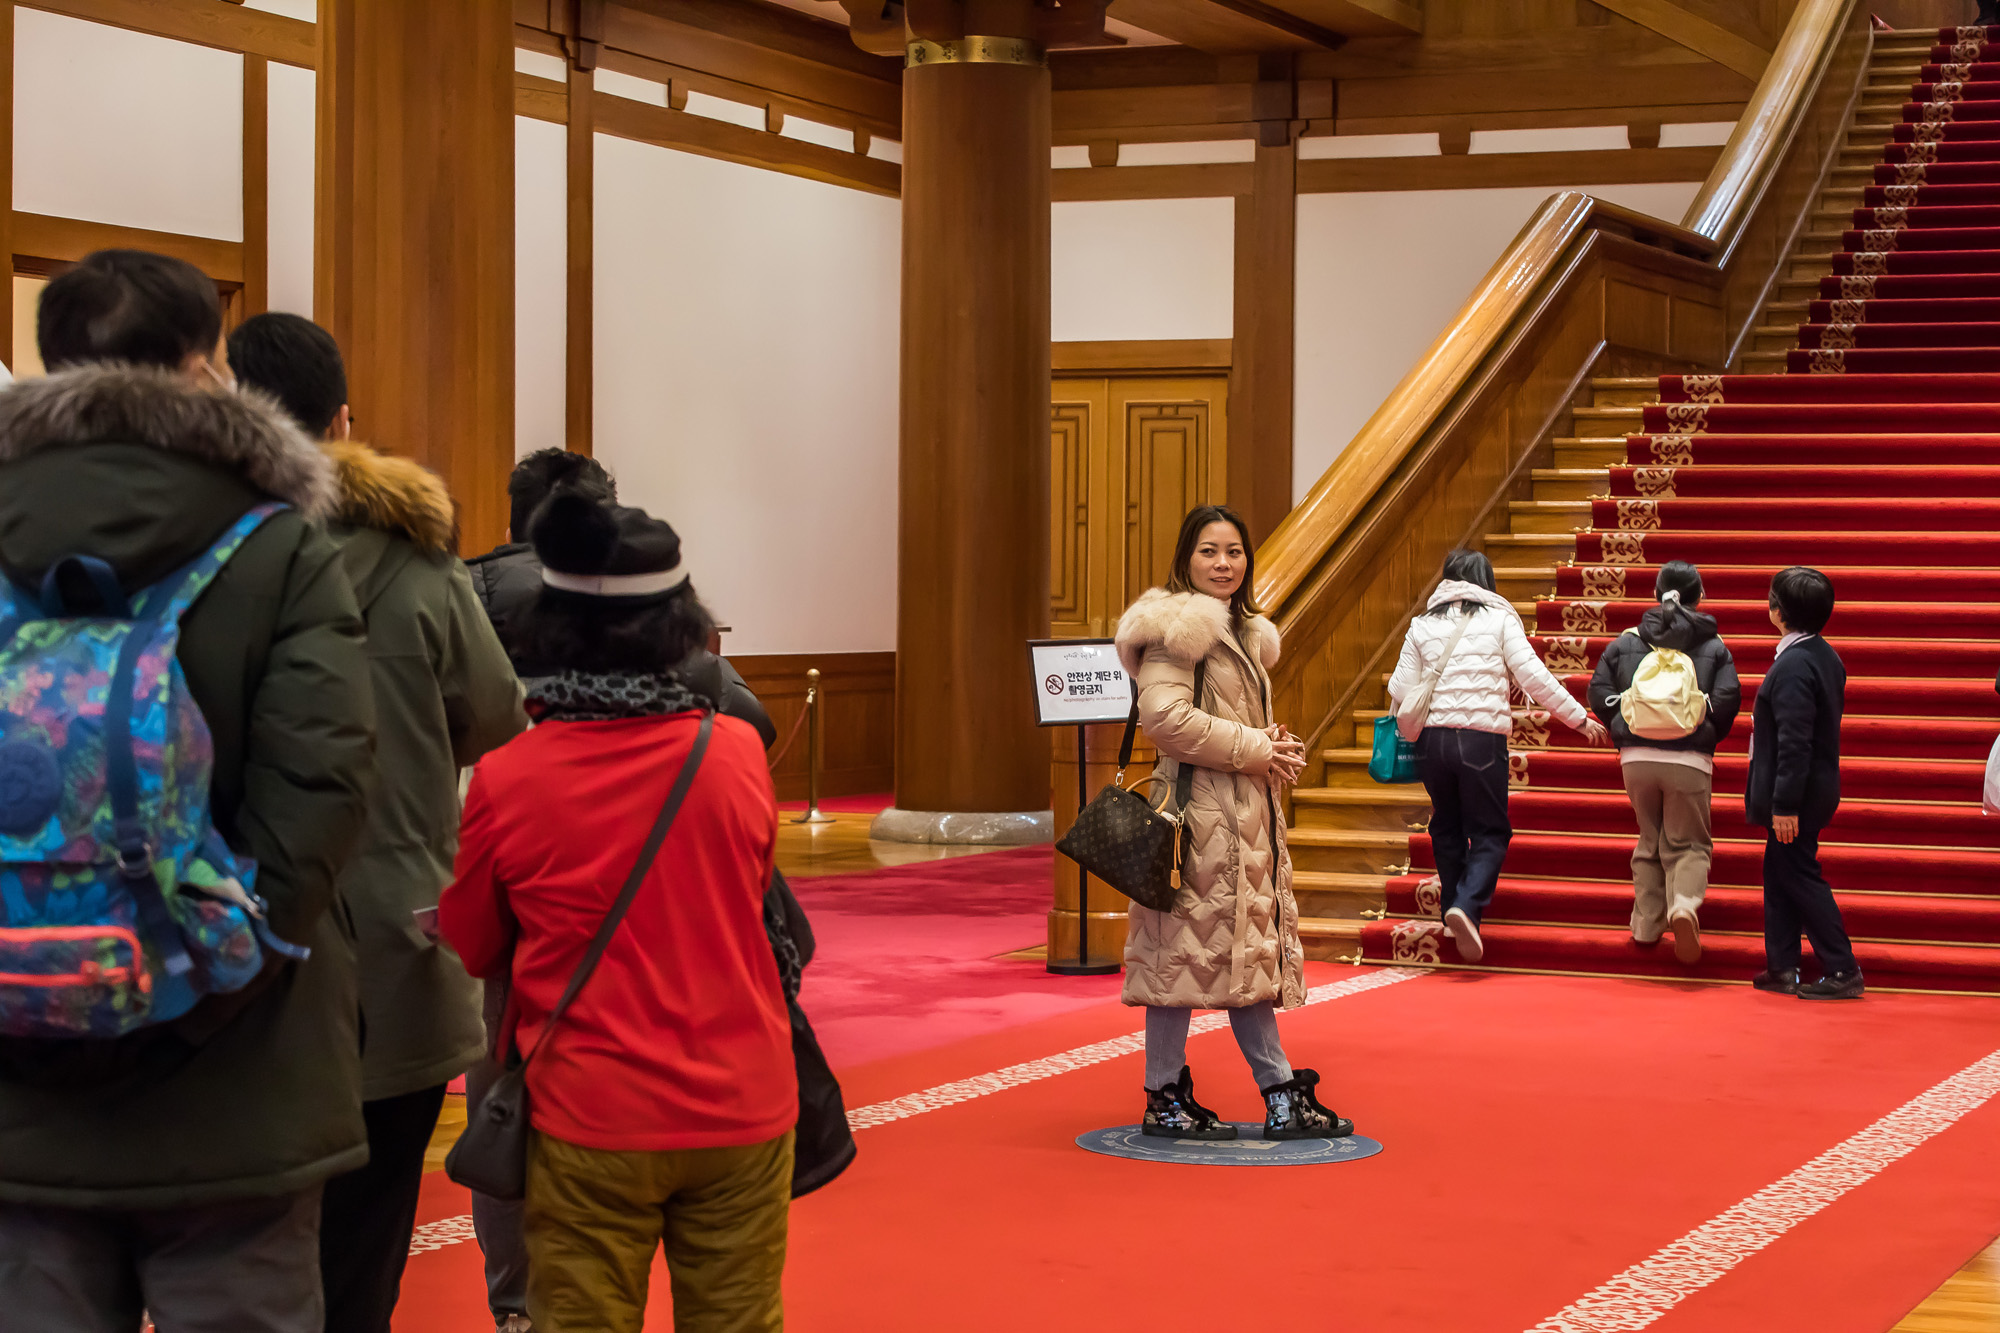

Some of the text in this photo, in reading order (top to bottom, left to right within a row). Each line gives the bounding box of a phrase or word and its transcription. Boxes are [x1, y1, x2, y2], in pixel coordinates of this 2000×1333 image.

[1066, 670, 1122, 682] 안전상 계단 위
[1068, 684, 1103, 696] 촬영금지
